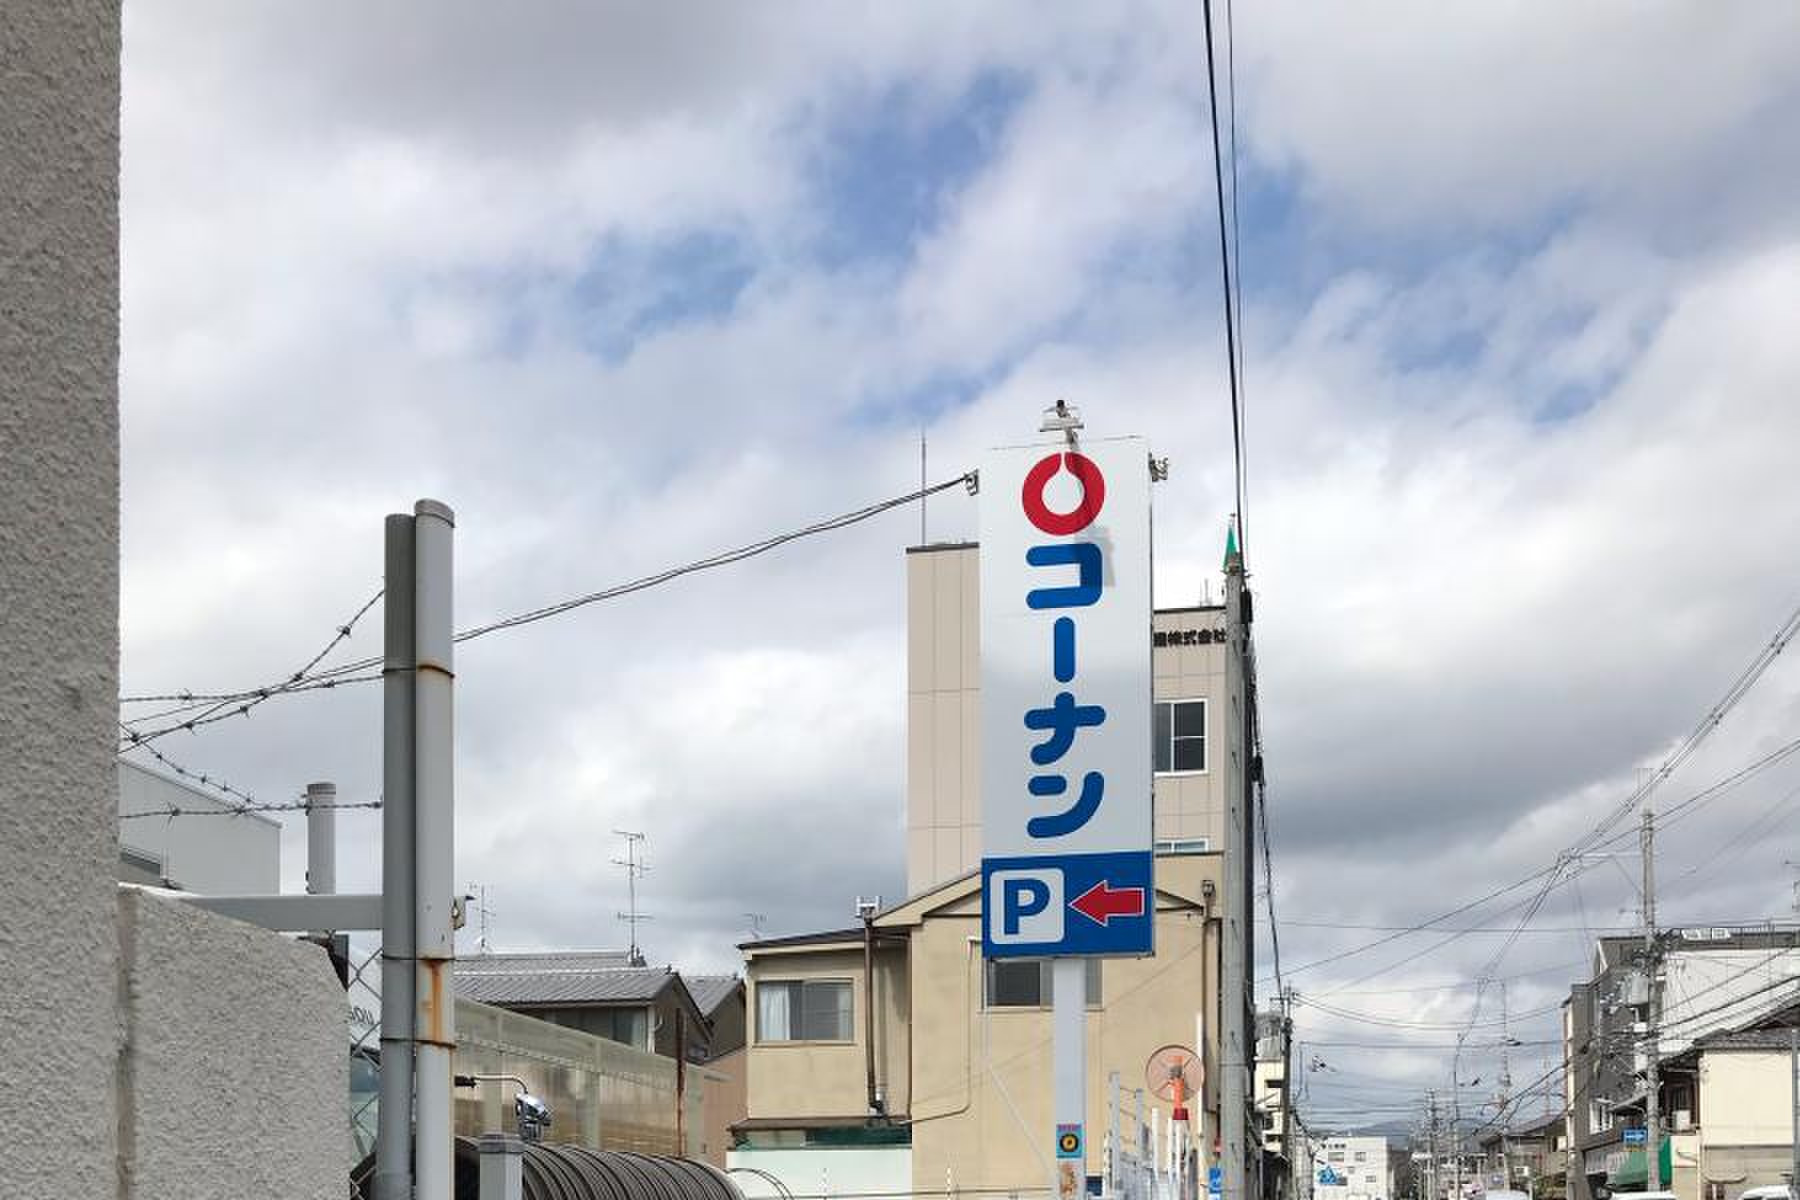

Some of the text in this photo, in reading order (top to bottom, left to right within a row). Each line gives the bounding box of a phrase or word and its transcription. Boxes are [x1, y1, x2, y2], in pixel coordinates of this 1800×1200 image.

[1024, 543, 1106, 839] コーナン
[1003, 878, 1050, 936] P
